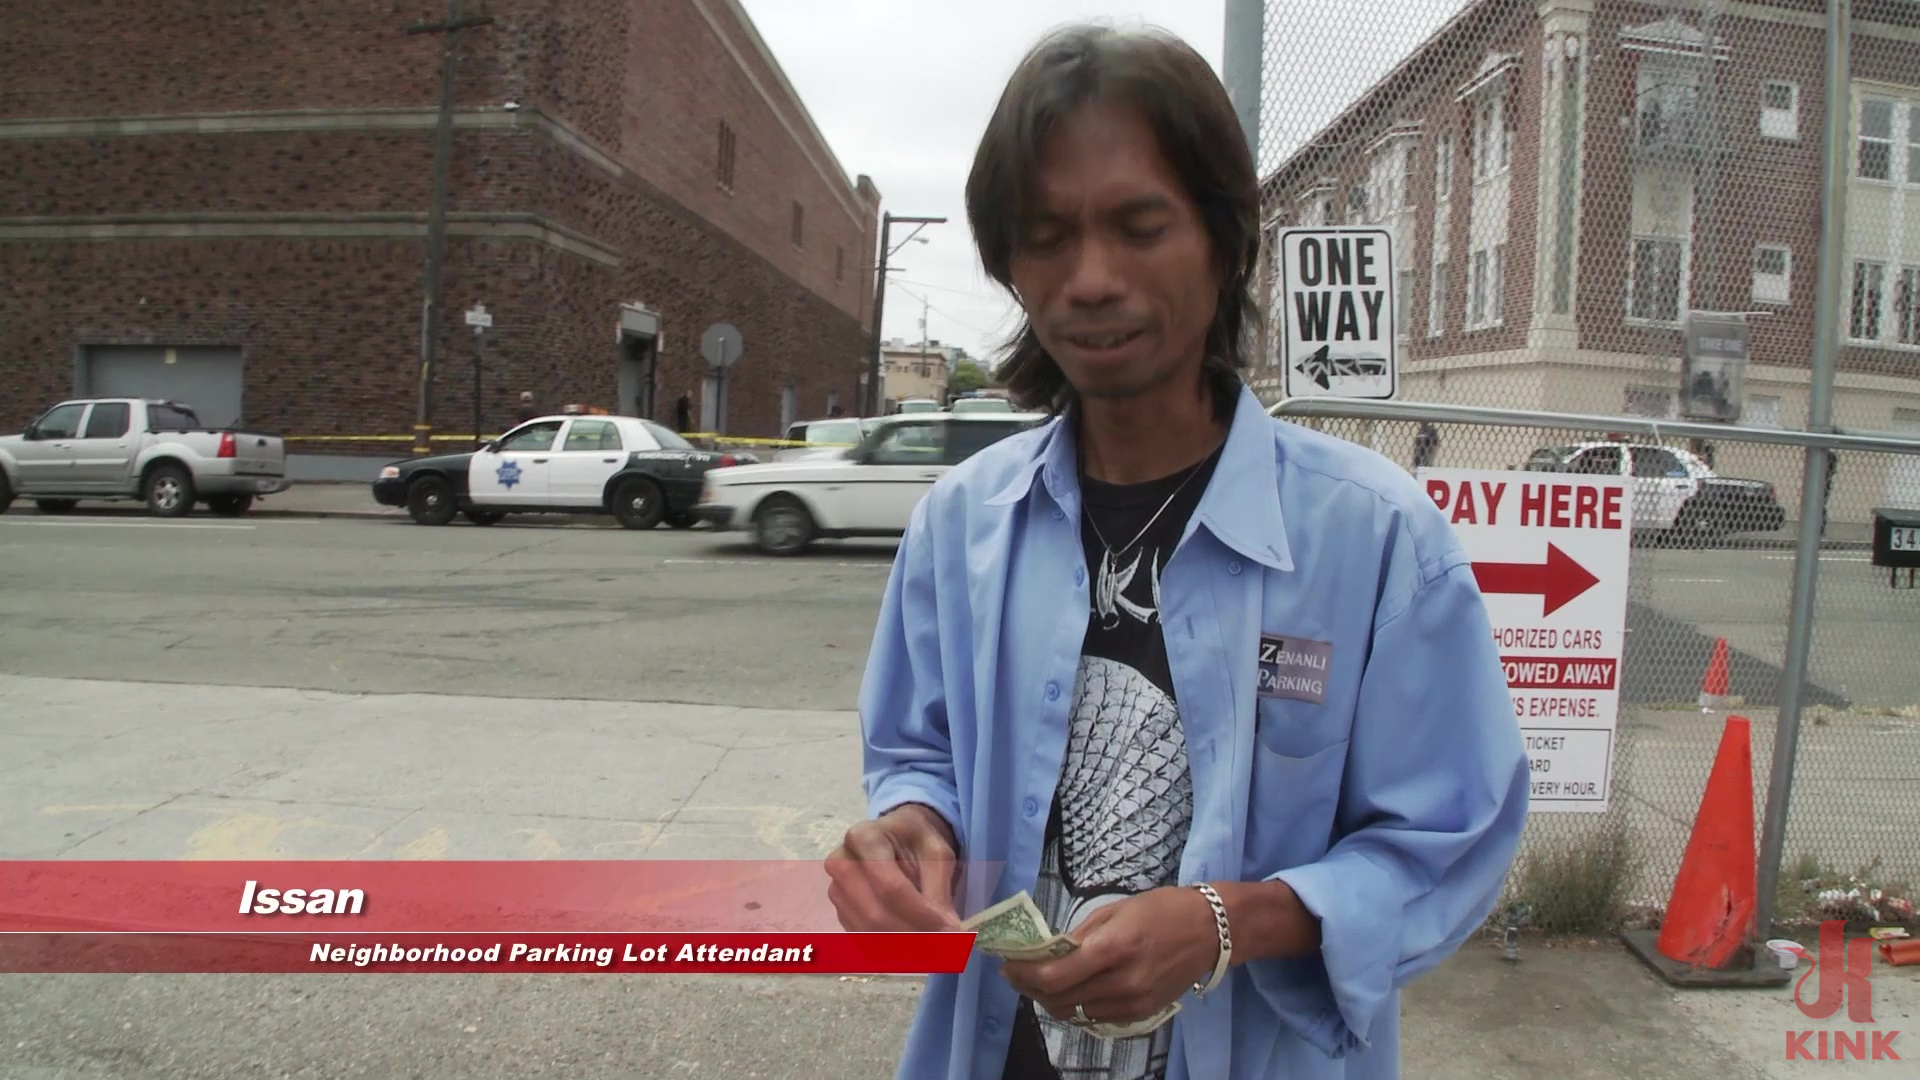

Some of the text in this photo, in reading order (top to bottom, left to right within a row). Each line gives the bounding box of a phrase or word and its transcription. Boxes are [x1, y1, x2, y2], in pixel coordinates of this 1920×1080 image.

[1299, 237, 1377, 287] ONE
[1294, 290, 1385, 342] WAY
[1427, 480, 1623, 530] PAY HERE
[1893, 528, 1920, 550] 34
[1492, 627, 1603, 650] HORIZED CARS
[1260, 643, 1327, 671] ZENANLI
[1257, 668, 1323, 695] PARKING
[1562, 663, 1613, 685] AWAY
[1529, 697, 1600, 718] EXPENSE.
[1526, 736, 1566, 751] TICKET
[1531, 781, 1598, 796] VERY HOUR.
